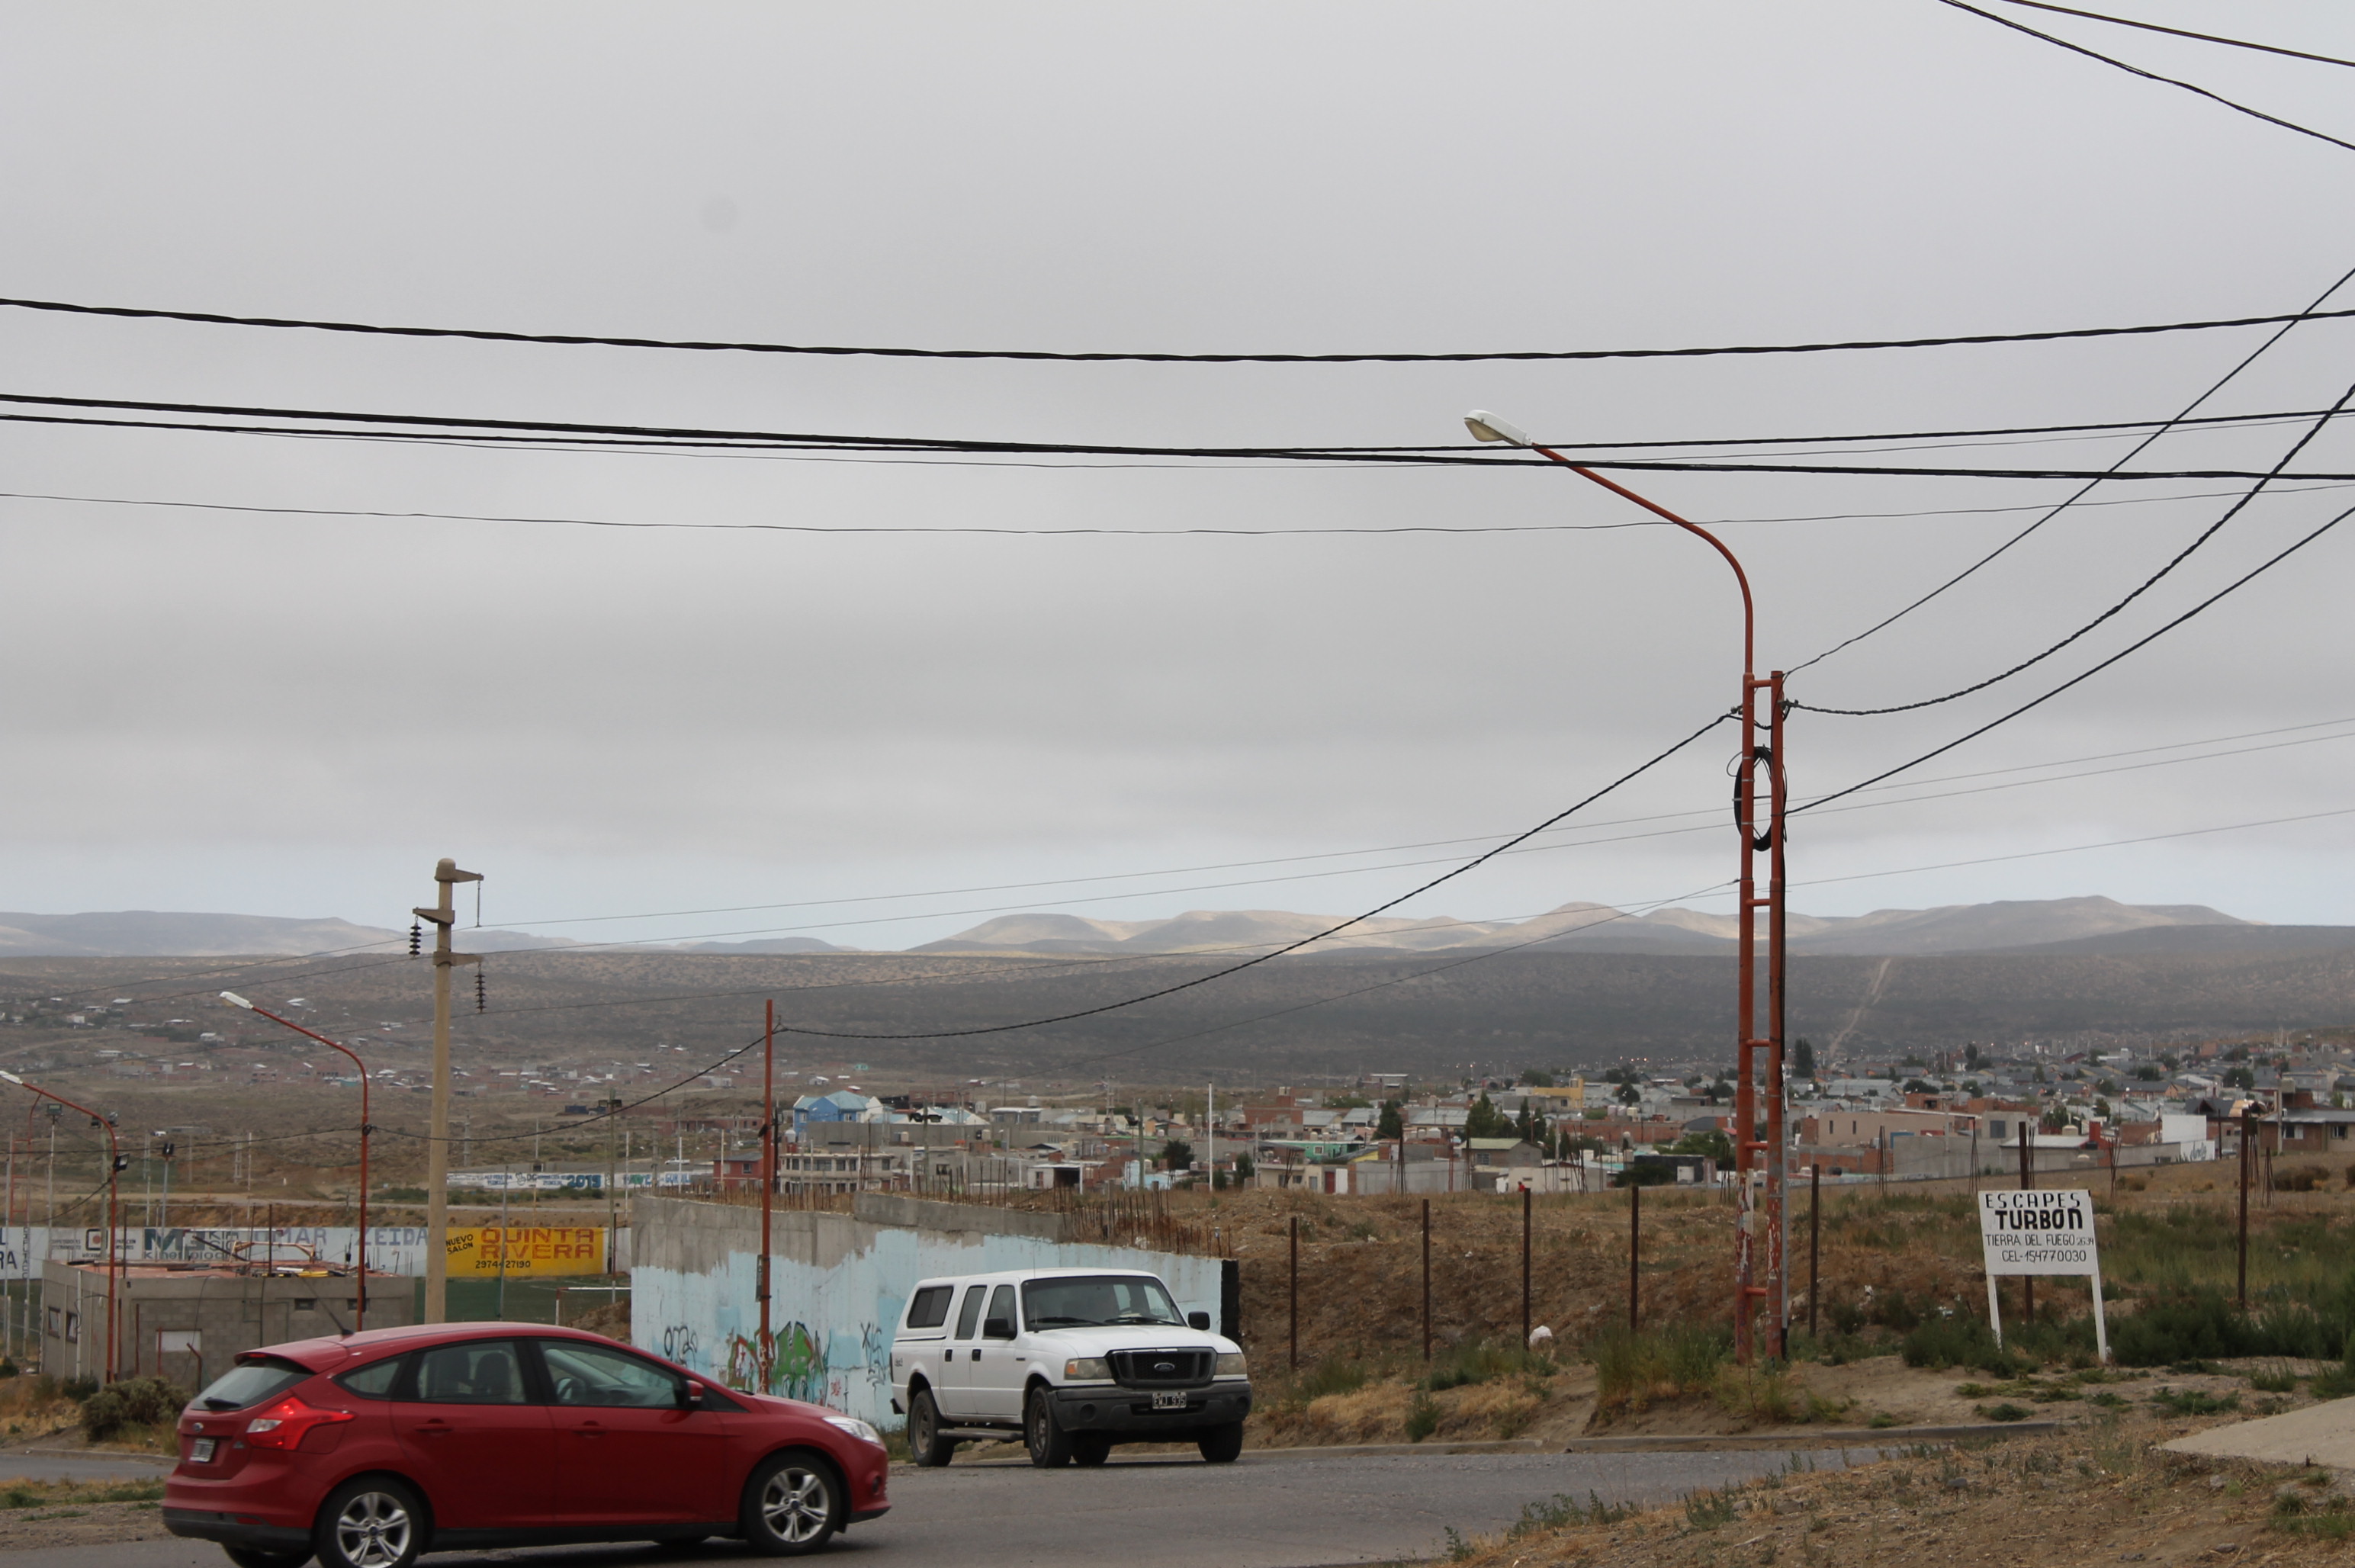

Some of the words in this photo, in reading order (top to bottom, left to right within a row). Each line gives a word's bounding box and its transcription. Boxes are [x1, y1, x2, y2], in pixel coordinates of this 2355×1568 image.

[567, 1175, 601, 1187] 2019
[1985, 1193, 2080, 1209] ESCAPES
[445, 1234, 474, 1247] NUEVO
[480, 1229, 594, 1243] QUINTA
[1985, 1234, 2021, 1246] TIERRA
[2025, 1234, 2042, 1246] DEL
[2046, 1234, 2075, 1246] FUEGO
[447, 1242, 474, 1255] SALON
[480, 1244, 594, 1259] RIVERA
